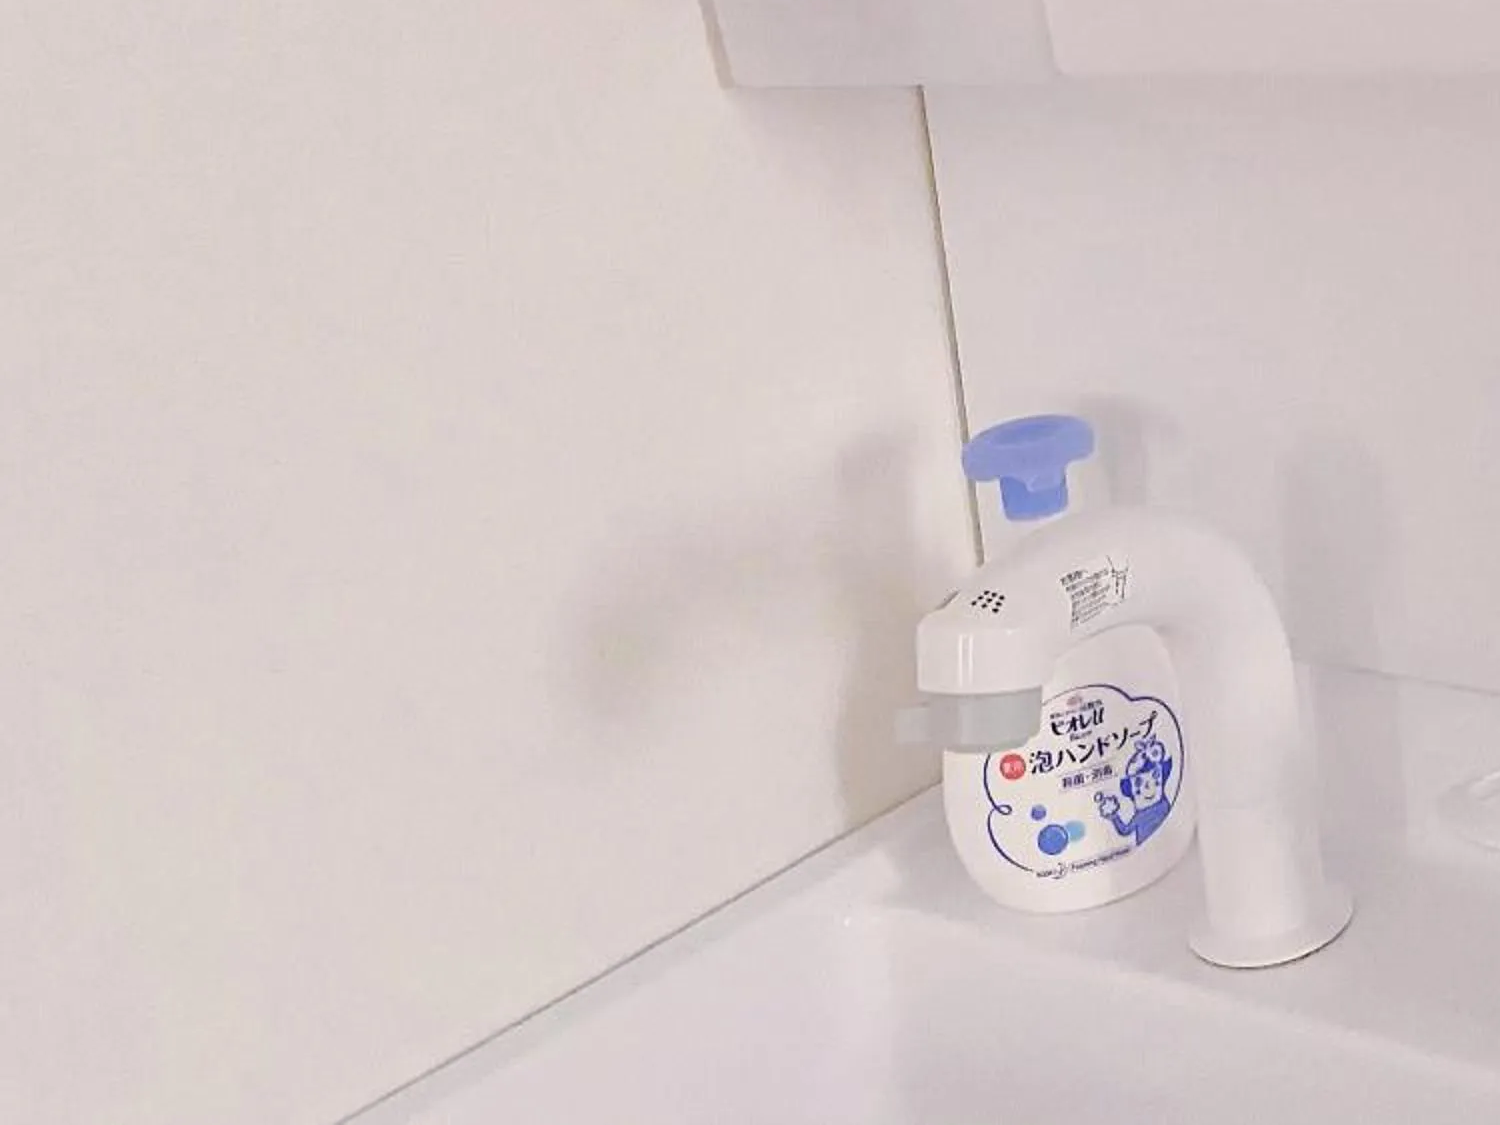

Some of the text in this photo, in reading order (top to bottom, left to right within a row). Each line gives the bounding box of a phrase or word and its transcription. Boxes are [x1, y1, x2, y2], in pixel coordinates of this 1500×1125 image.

[1029, 710, 1158, 775] 泡ハンドソープ
